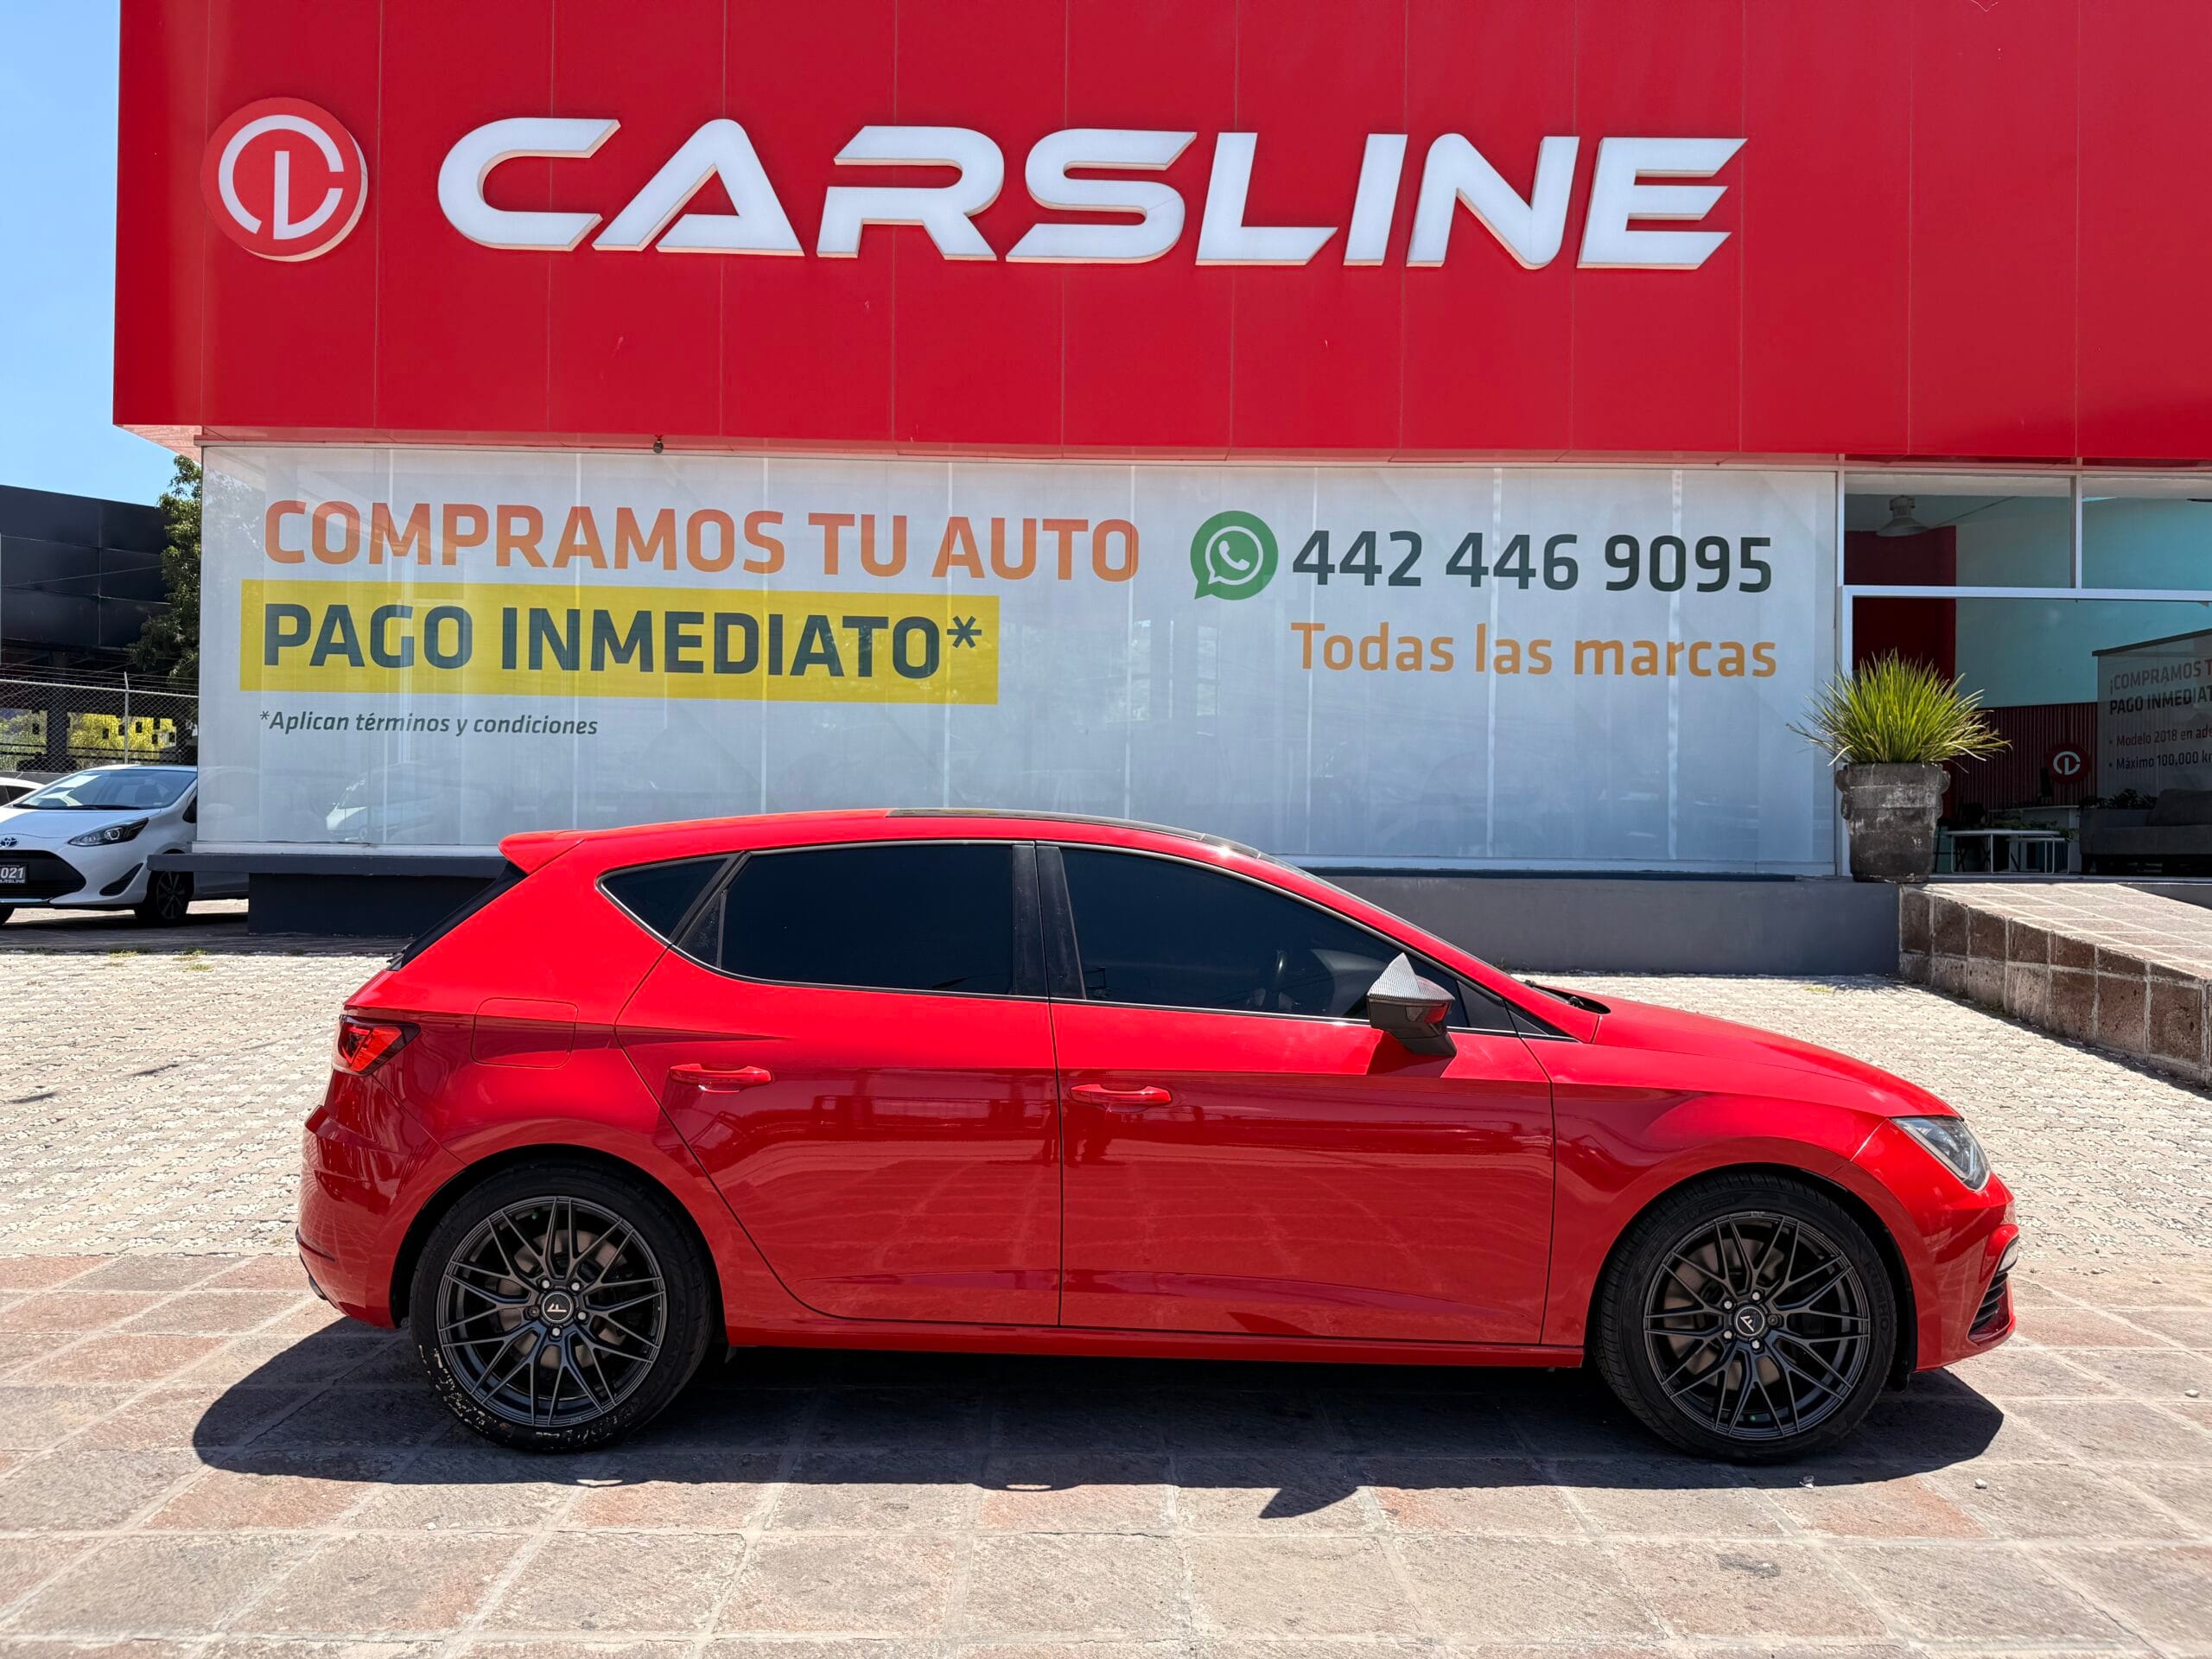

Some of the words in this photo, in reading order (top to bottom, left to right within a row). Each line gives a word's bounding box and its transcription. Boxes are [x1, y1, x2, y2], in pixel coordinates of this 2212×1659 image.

[437, 117, 1748, 271] CARSLINE
[265, 499, 785, 574] COMPRAMOS
[808, 512, 907, 577] TU
[931, 517, 1140, 582] AUTO
[1292, 531, 1422, 588] 442
[1446, 532, 1580, 590] 446
[1604, 534, 1772, 594] 9095
[264, 602, 474, 671] PAGO
[1290, 621, 1455, 672] Todas
[1475, 623, 1553, 676] las
[1573, 639, 1777, 677] marcas
[355, 712, 450, 733] términos
[455, 717, 468, 737] y
[473, 715, 599, 735] condiciones
[2109, 695, 2144, 715] PAGO
[2116, 733, 2152, 747] Modelo
[2154, 728, 2177, 744] 2018
[2180, 728, 2193, 741] en
[2116, 755, 2155, 771] Máximo
[2157, 750, 2199, 767] 100,000
